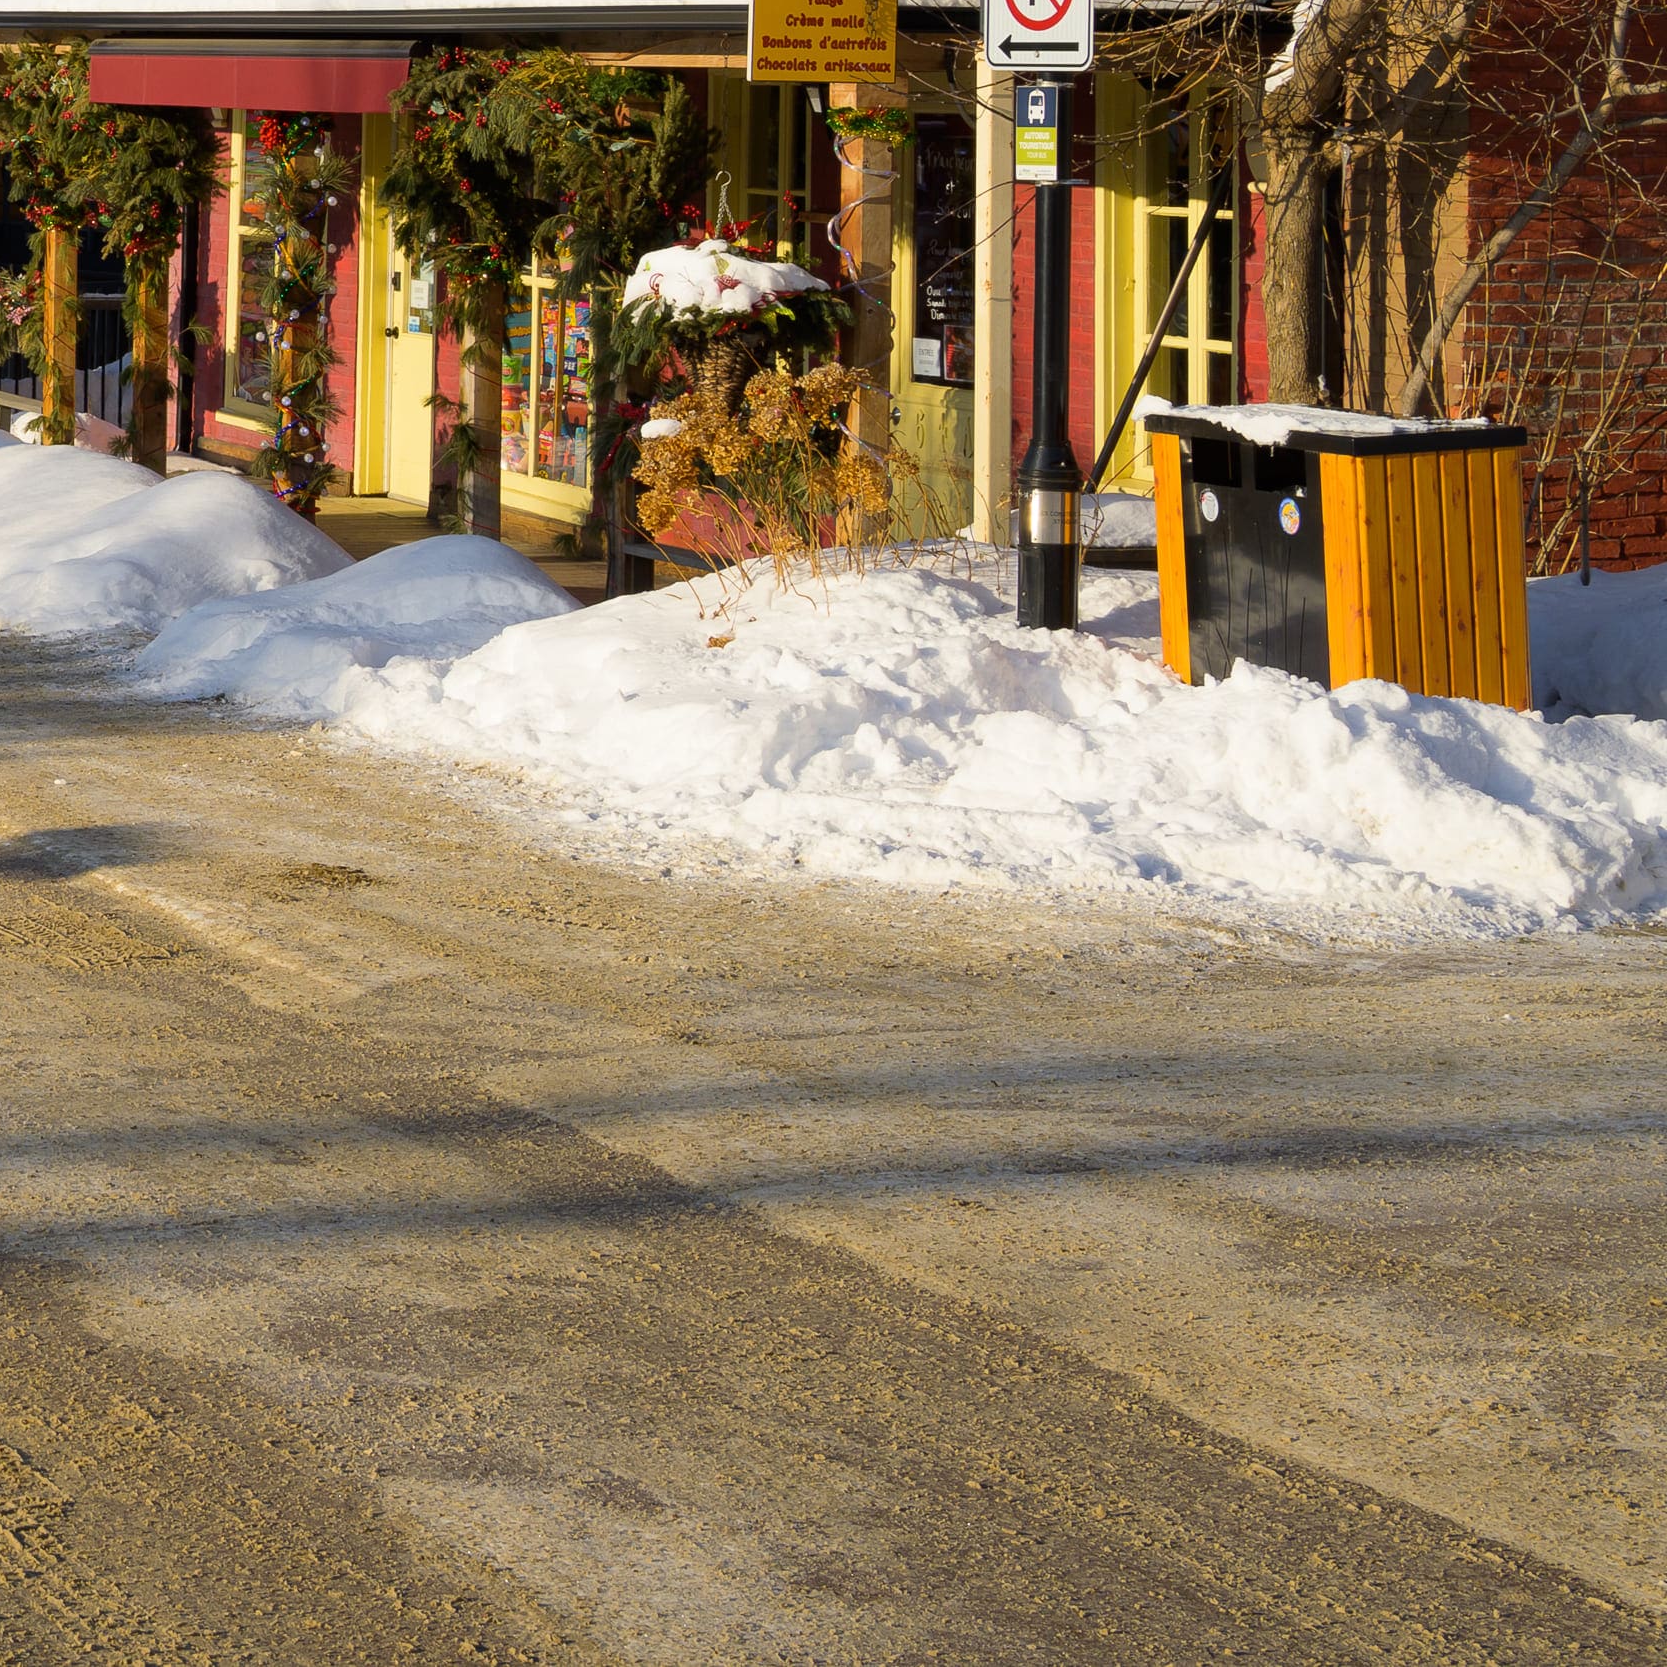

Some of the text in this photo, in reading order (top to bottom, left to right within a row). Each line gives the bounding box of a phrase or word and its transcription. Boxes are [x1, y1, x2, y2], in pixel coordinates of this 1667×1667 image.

[785, 13, 865, 28] Crème molle
[762, 35, 887, 51] Bonbons d'autrefois
[756, 56, 891, 73] Chocolats artisanaux
[1024, 131, 1051, 140] AUTOBUS
[1019, 141, 1055, 151] TOURISTIQUE
